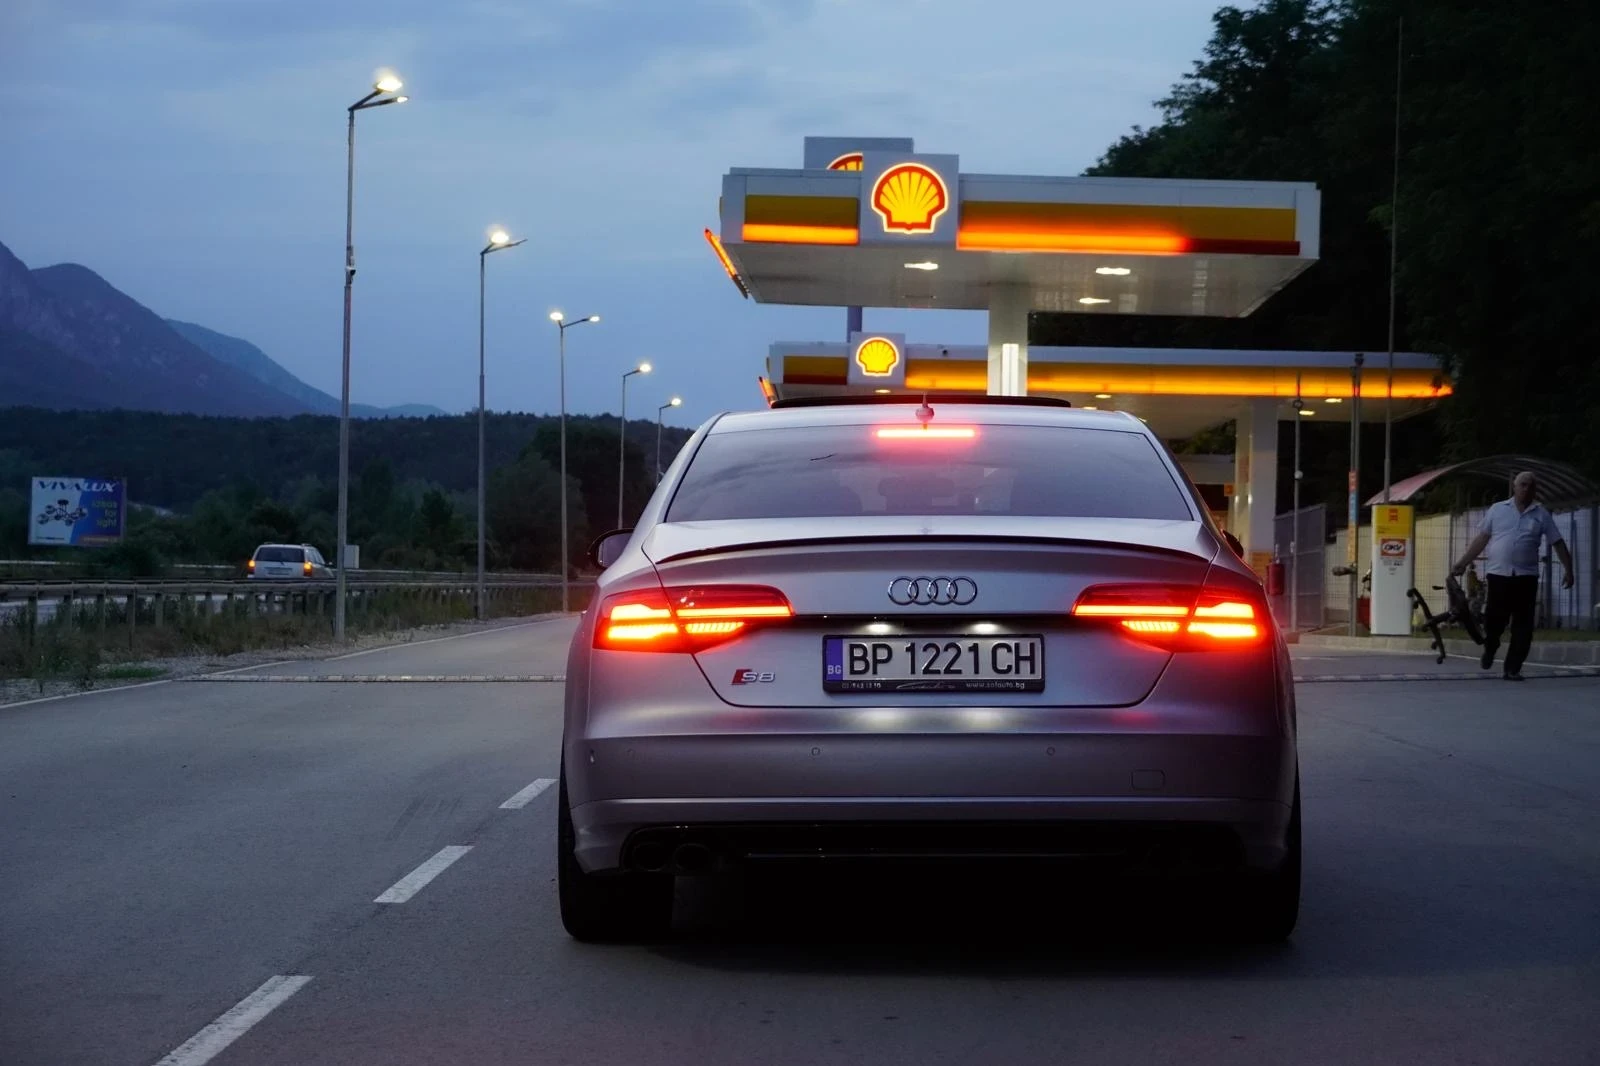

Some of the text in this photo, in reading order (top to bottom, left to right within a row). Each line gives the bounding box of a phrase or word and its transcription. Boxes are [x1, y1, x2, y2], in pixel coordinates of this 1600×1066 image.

[38, 480, 116, 492] VIVALUX
[104, 509, 117, 518] for
[849, 642, 1036, 675] BP 1221 CH
[827, 664, 842, 675] BG
[741, 671, 776, 683] S8
